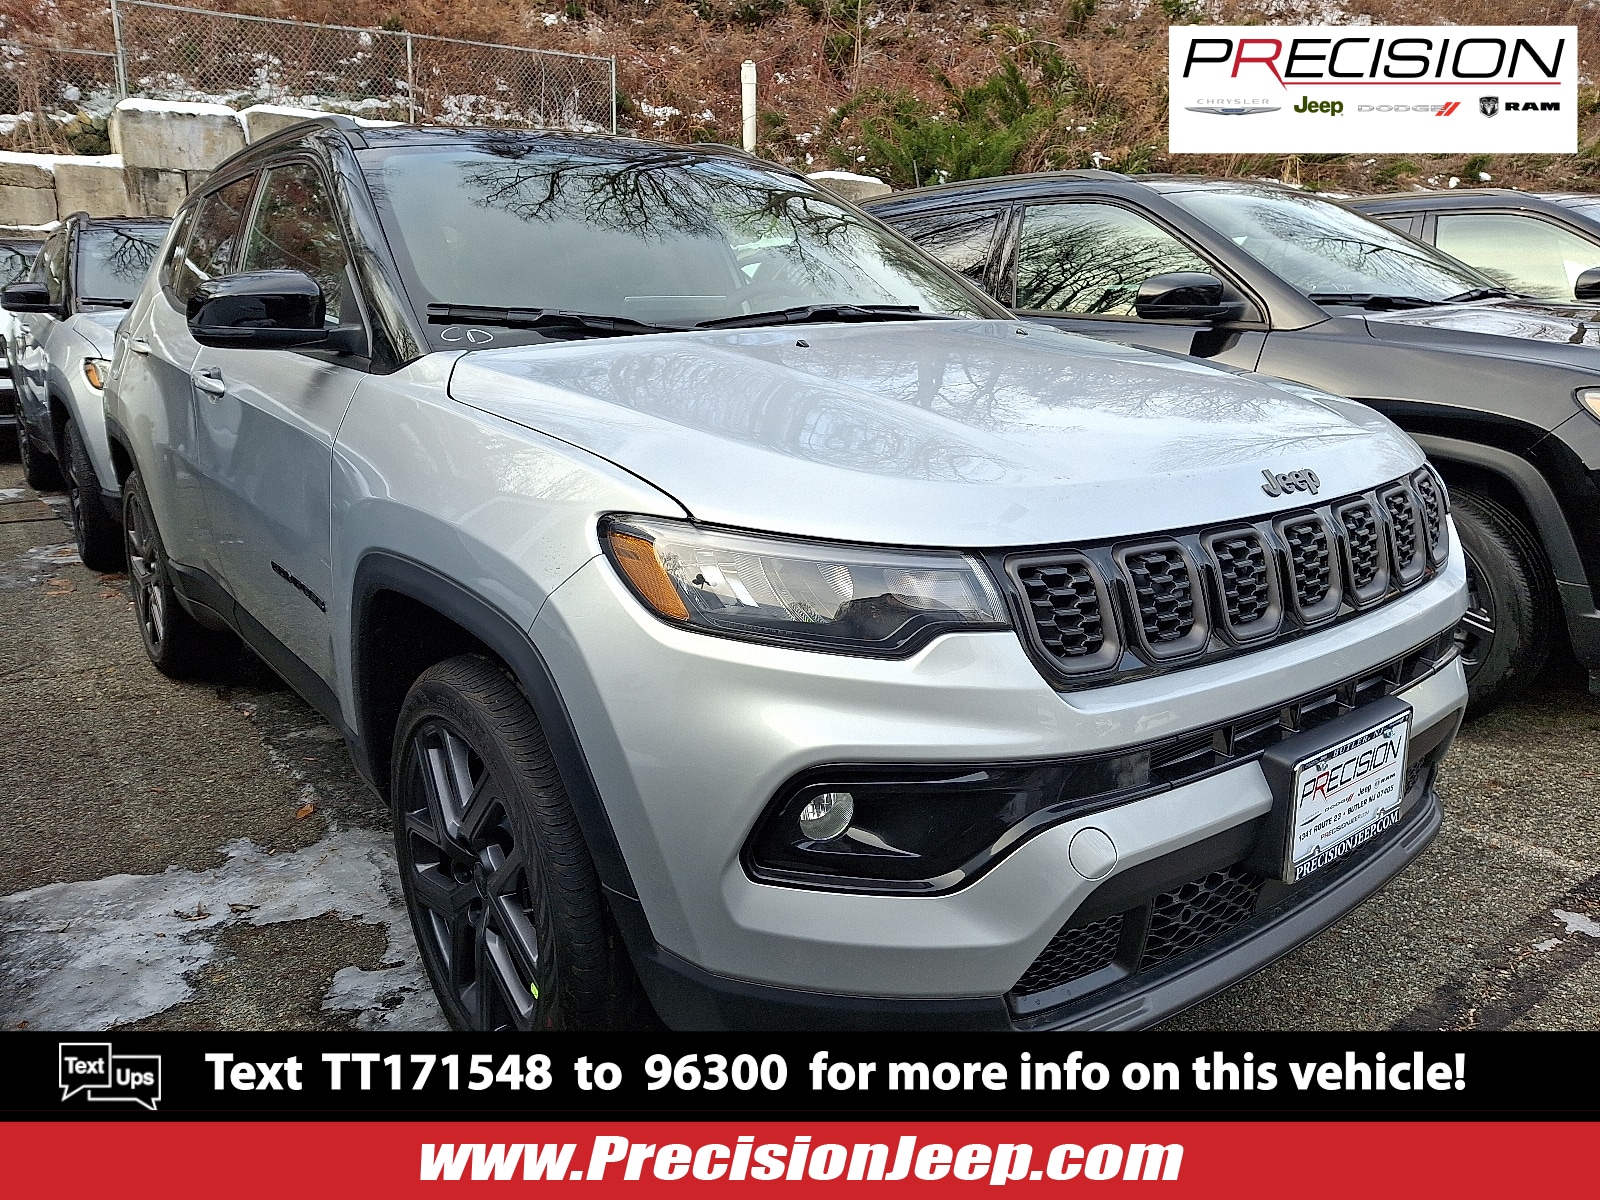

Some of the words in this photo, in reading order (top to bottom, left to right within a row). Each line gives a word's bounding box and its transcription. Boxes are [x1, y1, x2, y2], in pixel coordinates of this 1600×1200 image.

[440, 326, 494, 345] CD
[1261, 468, 1320, 498] Jeep
[1299, 735, 1402, 809] PRECISION
[1357, 783, 1372, 798] Jeep
[1314, 817, 1332, 834] ROUTE
[1347, 798, 1367, 815] BUTLER
[1295, 809, 1400, 881] PRECISIONJEEP.COM
